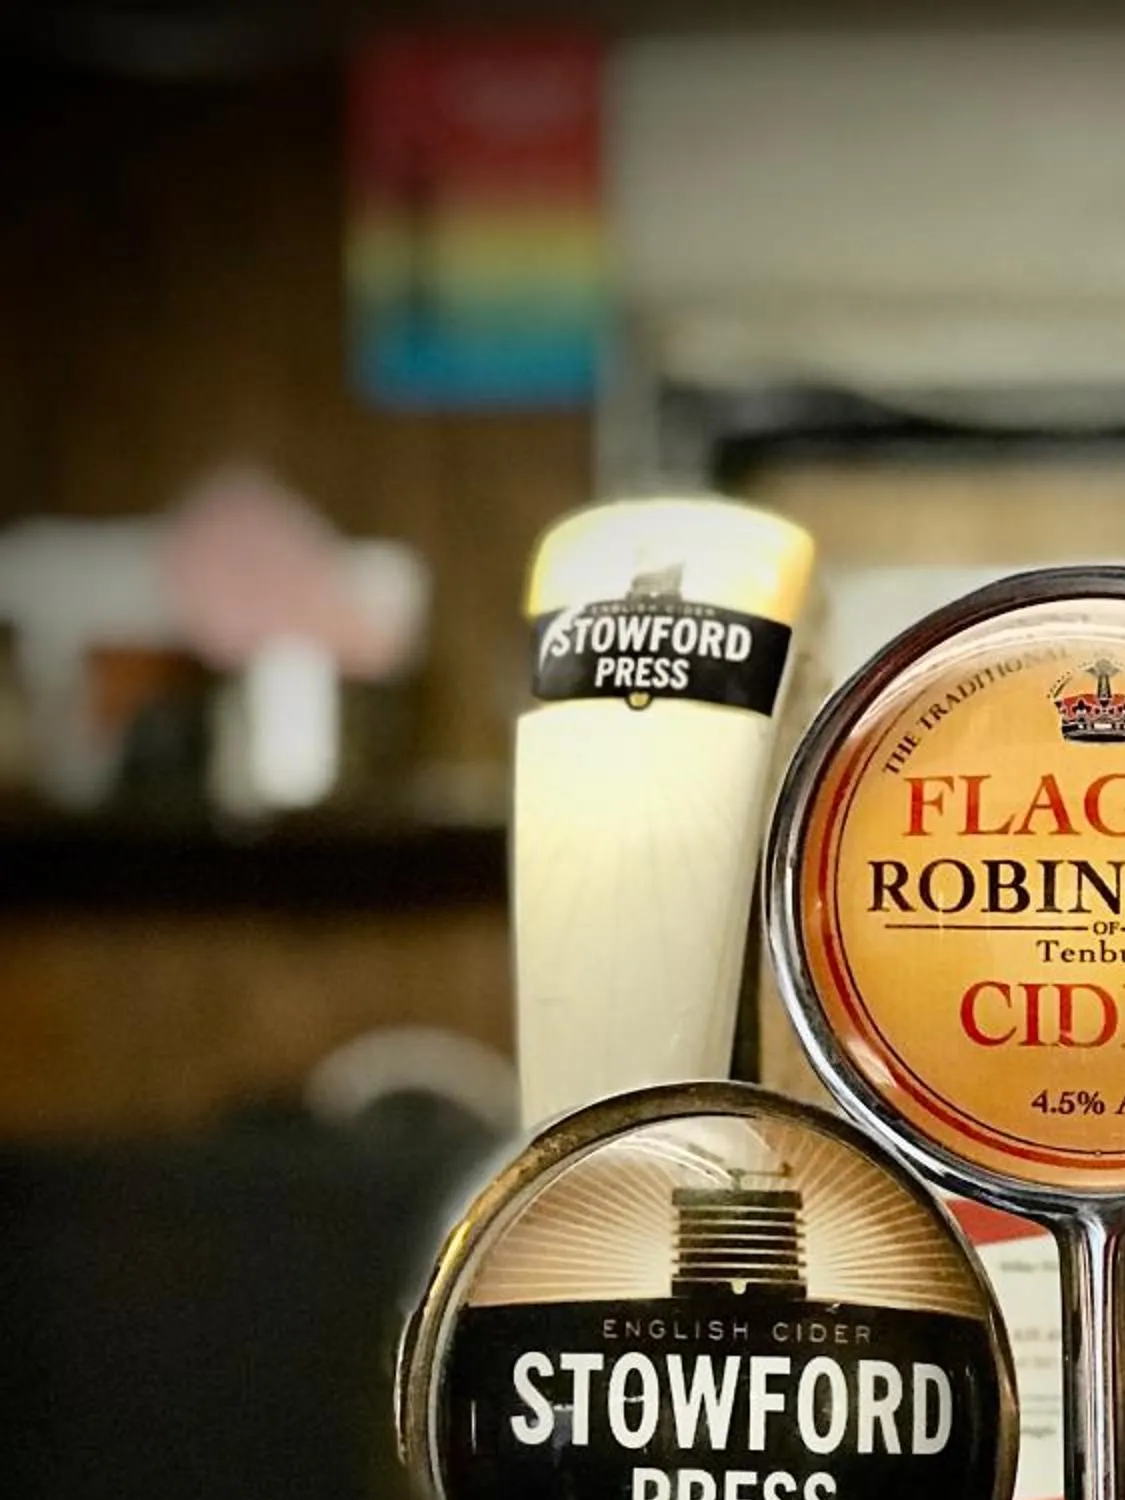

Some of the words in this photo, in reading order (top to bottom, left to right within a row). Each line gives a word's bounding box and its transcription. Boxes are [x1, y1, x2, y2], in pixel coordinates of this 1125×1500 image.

[551, 615, 752, 662] STOWFORD
[594, 657, 690, 690] PRESS
[882, 731, 922, 775] THE
[1092, 920, 1122, 936] OF
[1030, 1089, 1106, 1116] 4.5%
[602, 1319, 750, 1342] ENGLISH
[772, 1321, 872, 1344] CIDER
[510, 1350, 954, 1456] STOWFORD
